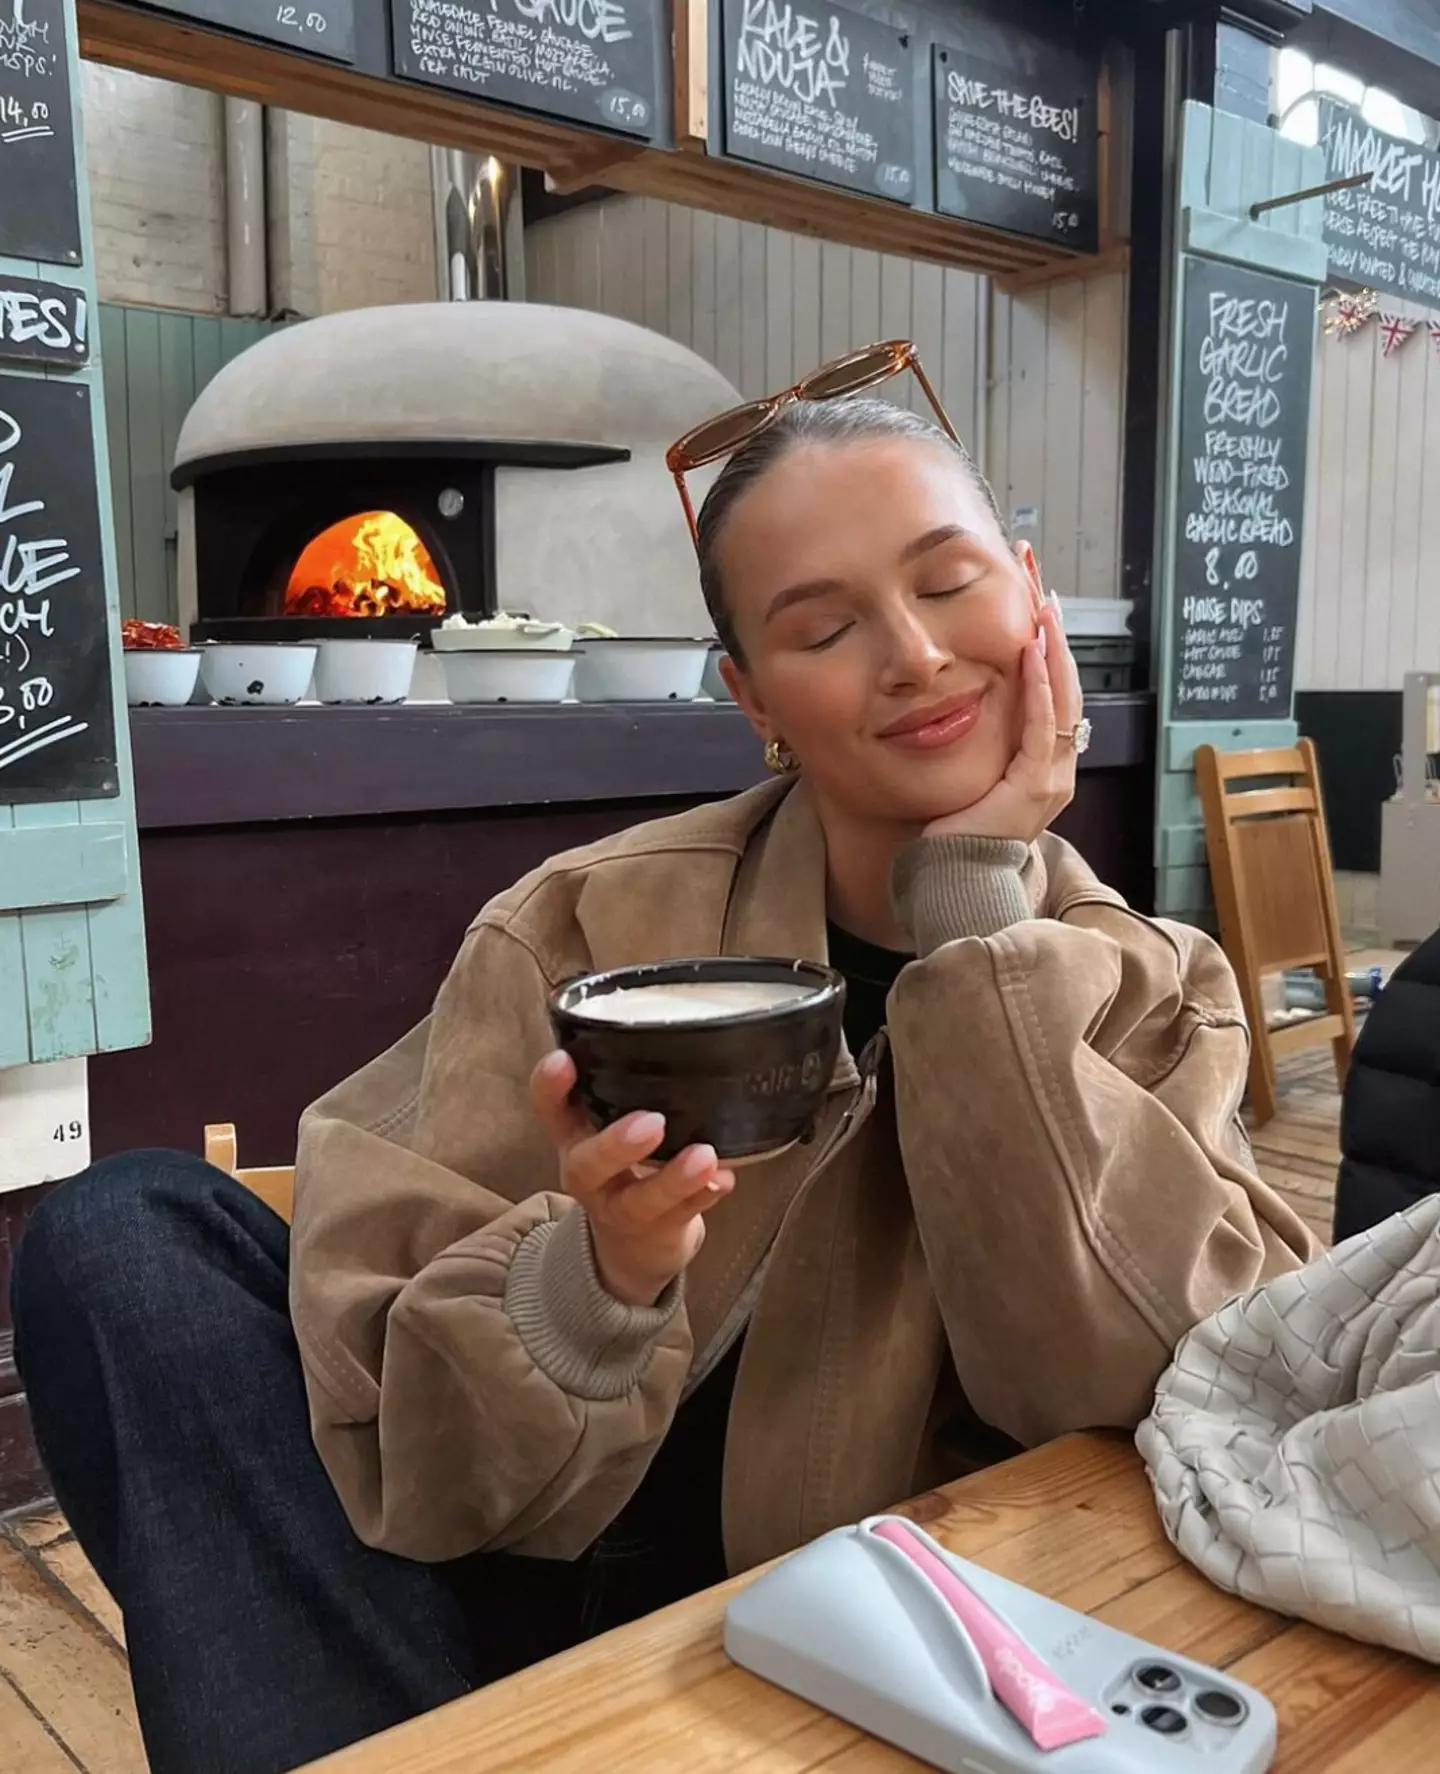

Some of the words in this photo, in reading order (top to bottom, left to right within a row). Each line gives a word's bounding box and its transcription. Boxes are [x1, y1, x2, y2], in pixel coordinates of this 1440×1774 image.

[740, 0, 823, 59] KALE
[825, 15, 851, 77] &
[737, 38, 847, 109] NDUJA
[947, 71, 995, 109] SAVE
[991, 89, 1030, 119] THE
[1028, 95, 1079, 144] BEES!
[1208, 290, 1288, 343] FRESH
[1199, 335, 1288, 384] GARLIC
[1203, 375, 1281, 429] BREAD
[1204, 429, 1282, 465] FRESHLY
[1185, 511, 1238, 545] GARLIC
[1238, 517, 1294, 546] BREAD
[1183, 595, 1227, 626] HOUSE
[1230, 596, 1264, 631] DIPS
[52, 1120, 83, 1143] 49
